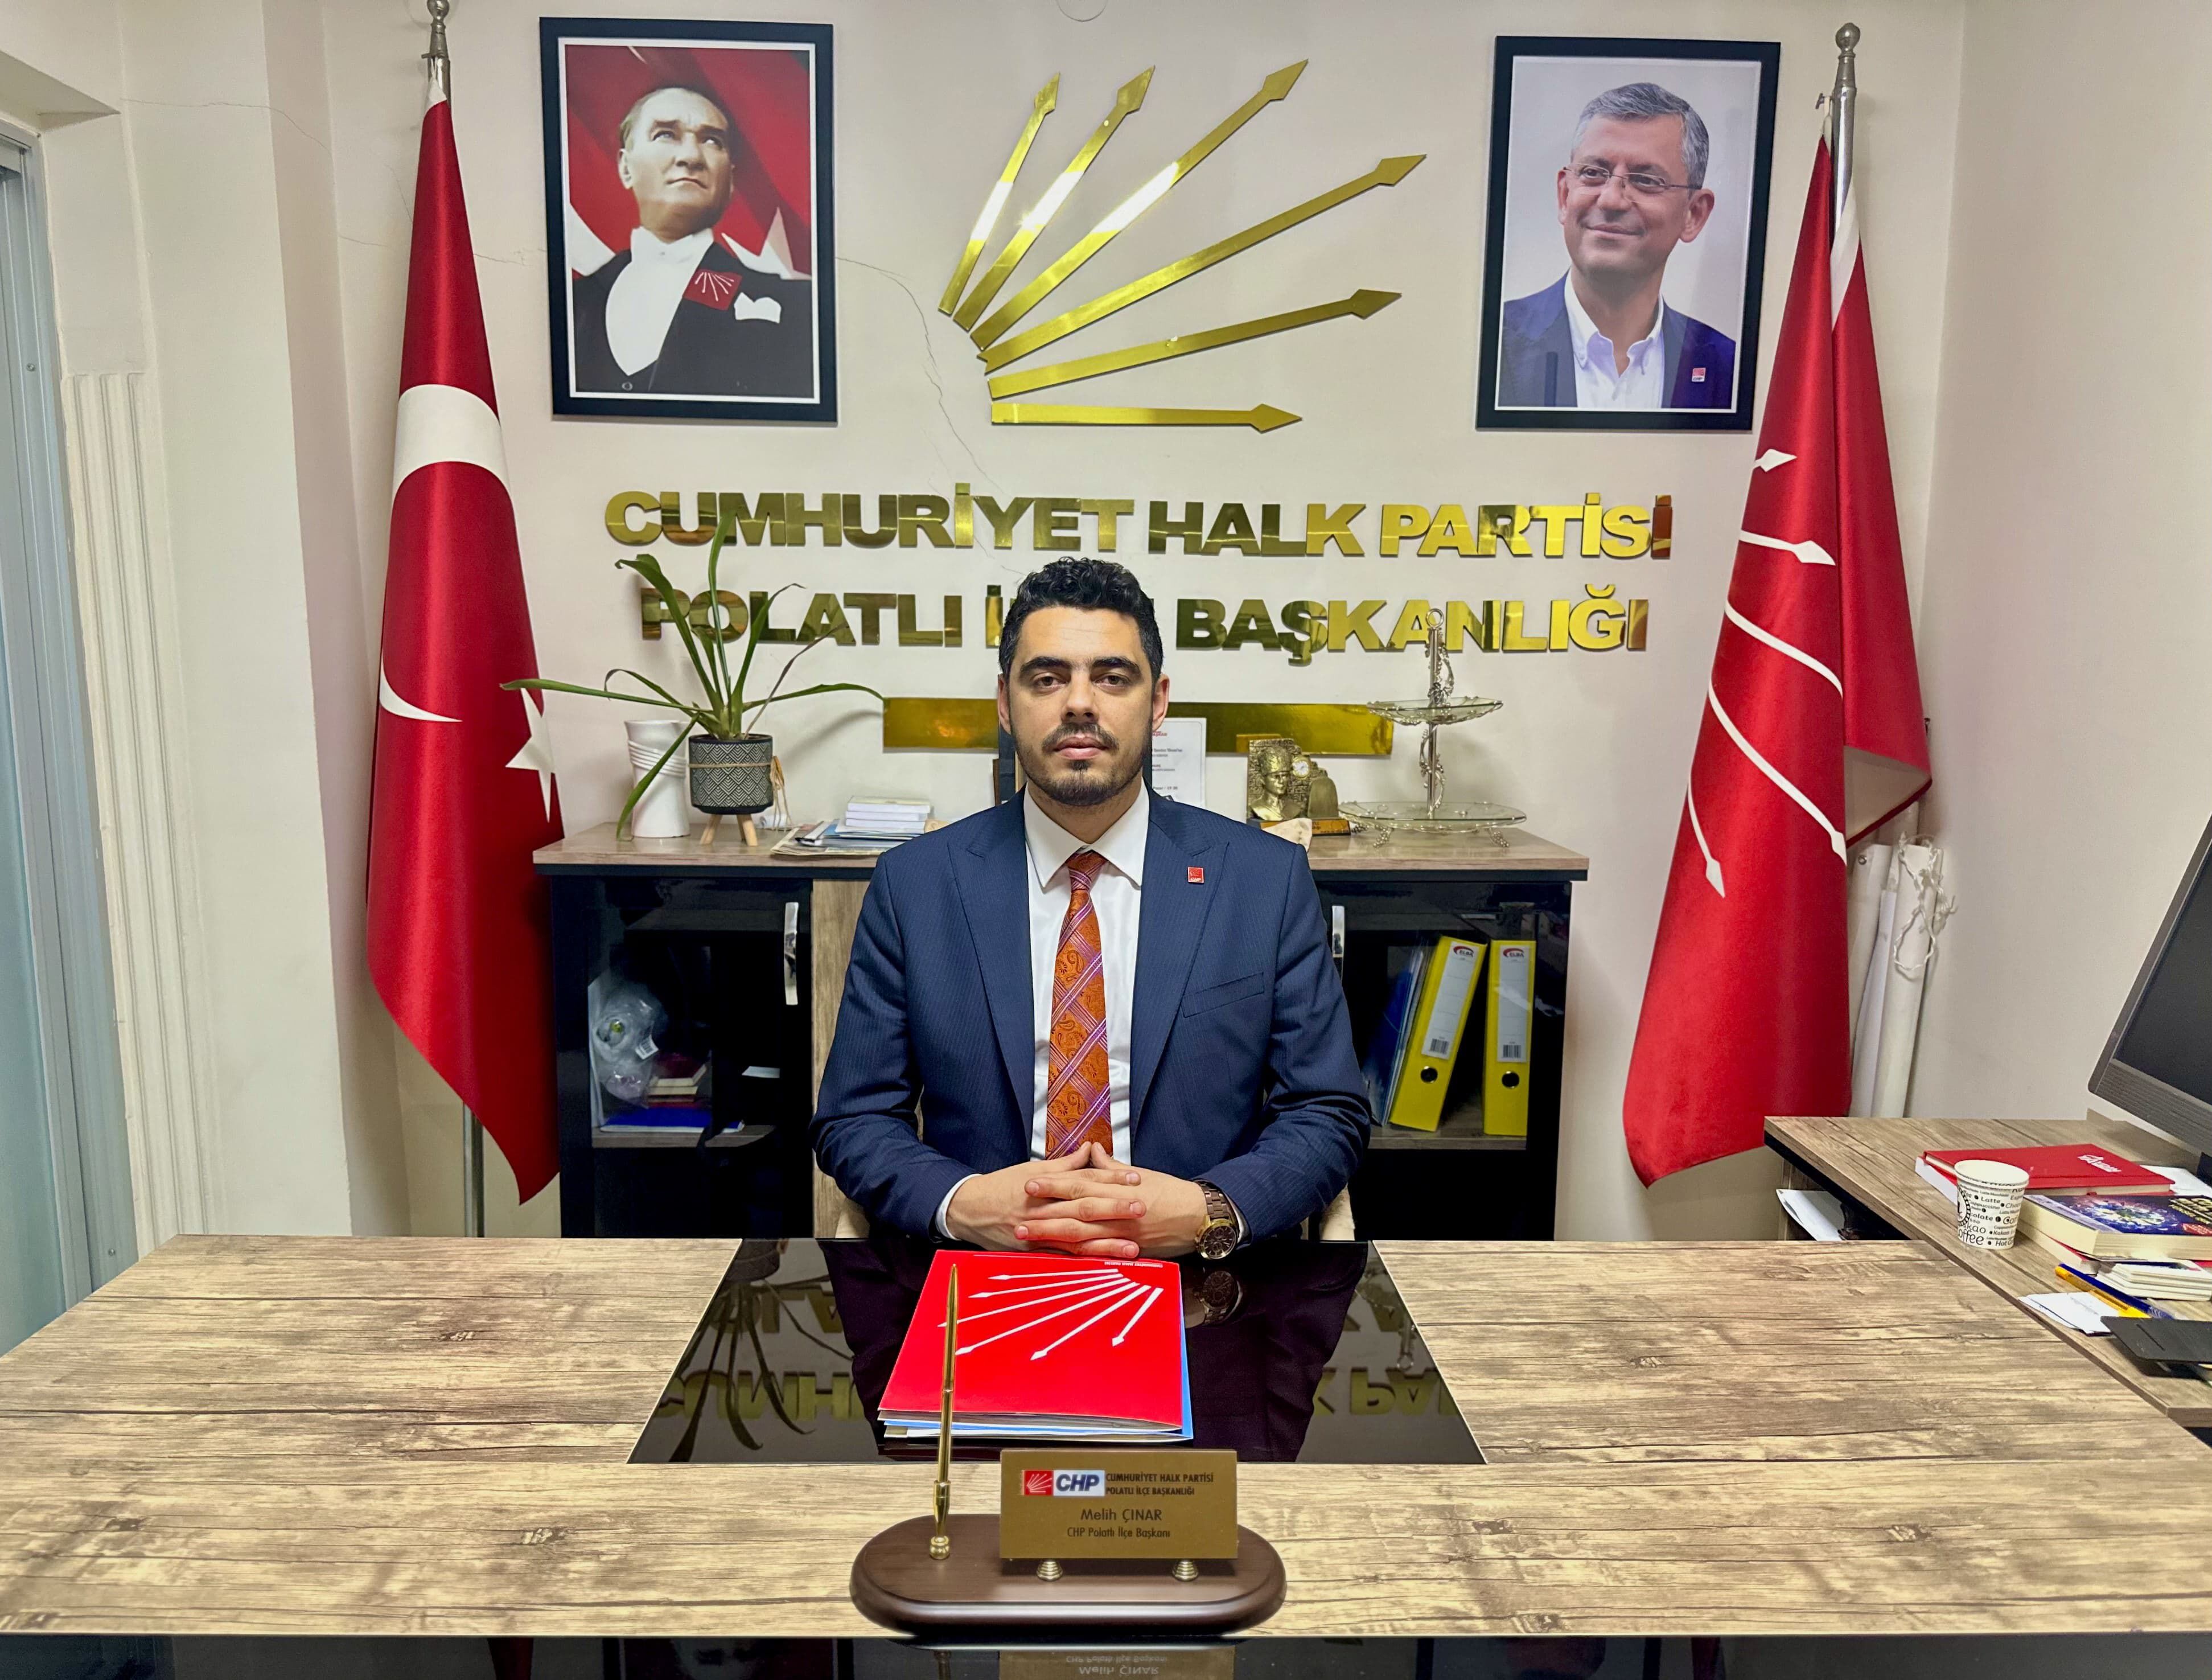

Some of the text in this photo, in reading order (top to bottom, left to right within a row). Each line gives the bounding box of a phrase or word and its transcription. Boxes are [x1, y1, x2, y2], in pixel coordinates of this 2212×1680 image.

[605, 482, 1673, 558] CUMHURİYET HALK PARTİSİ
[641, 586, 963, 647] POLATLI
[1175, 584, 1649, 667] BAŞKANLIĞI
[1971, 1212, 1993, 1221] olate
[1966, 1223, 1986, 1234] kao
[1056, 1474, 1100, 1492] CHP
[1106, 1472, 1214, 1483] CUMHURİYET HALK PARTİSİ
[1106, 1486, 1194, 1497] POLATLI İLÇE BAŞKANLIĞI
[1080, 1508, 1162, 1523] Melih ÇINAR
[1067, 1527, 1085, 1537] CHP
[1088, 1526, 1115, 1538] Polatlı
[1136, 1527, 1170, 1540] Başkanı
